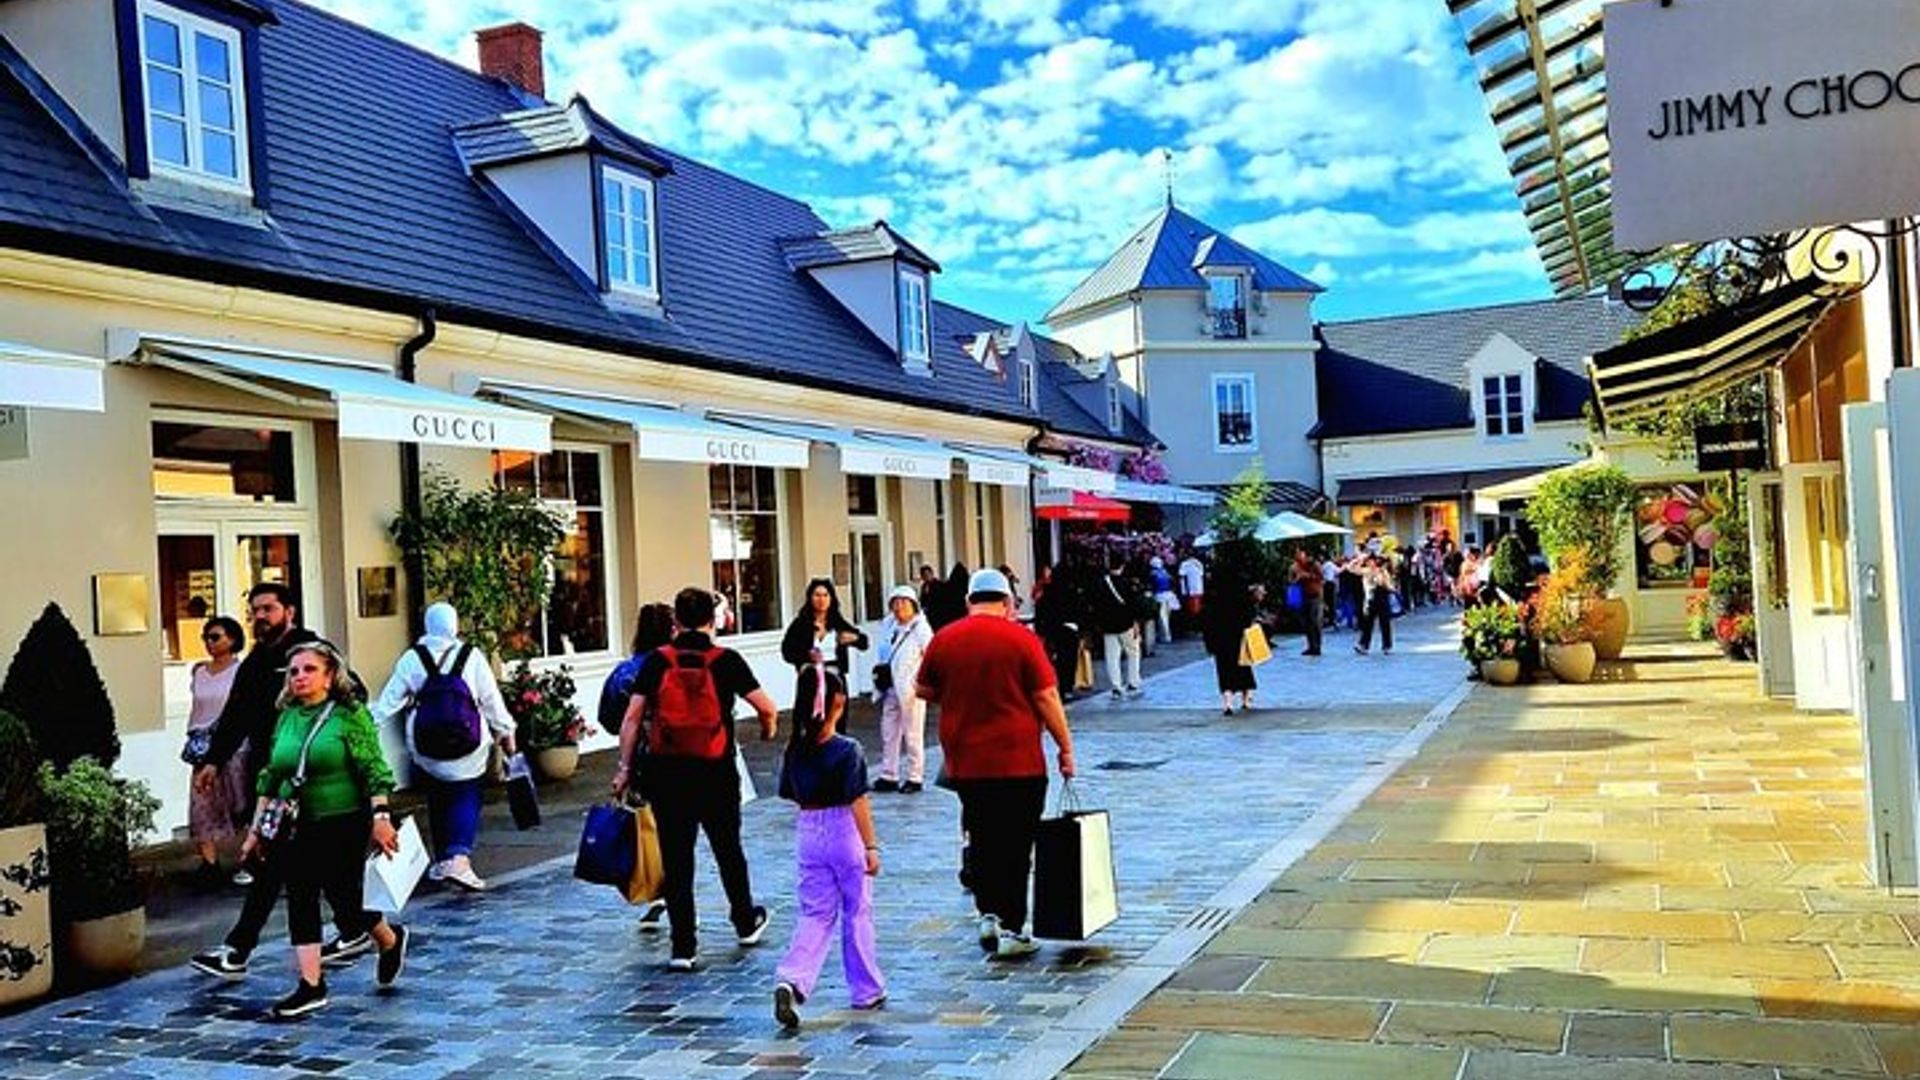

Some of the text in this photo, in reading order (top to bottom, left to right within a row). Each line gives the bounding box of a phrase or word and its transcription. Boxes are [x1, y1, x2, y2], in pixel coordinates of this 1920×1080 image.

[1647, 86, 1772, 140] JIMMY
[413, 414, 495, 441] GUCCI
[706, 441, 756, 460] GUCCI
